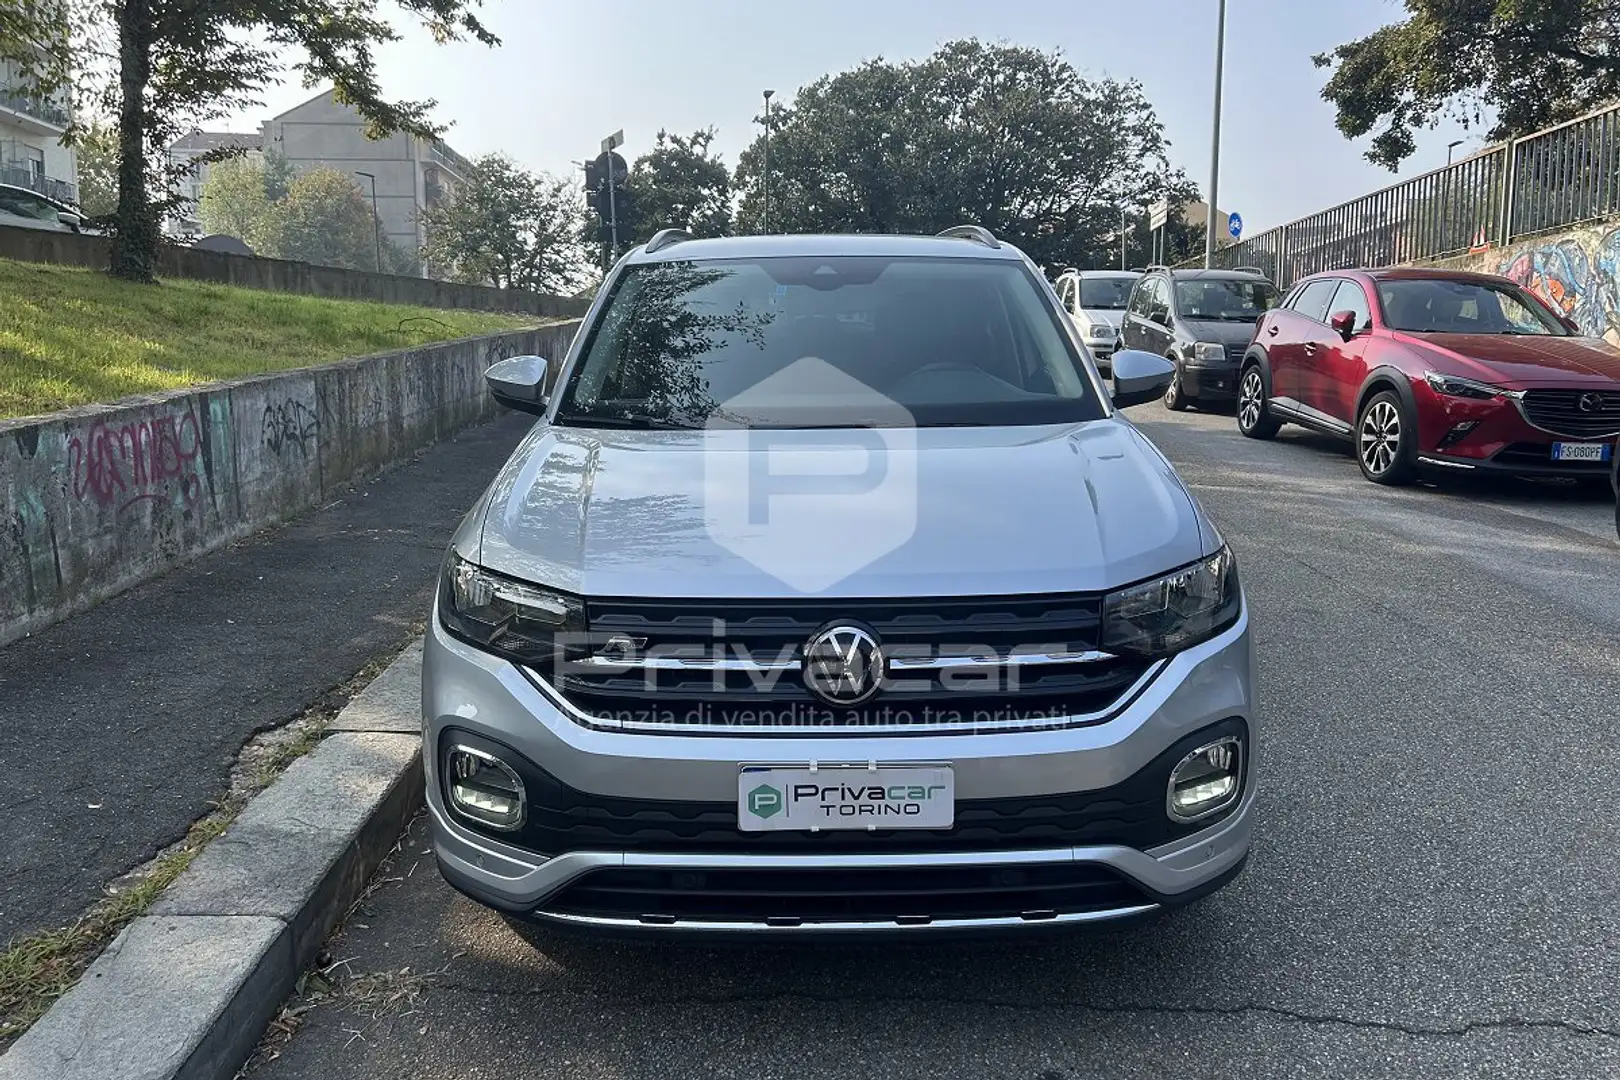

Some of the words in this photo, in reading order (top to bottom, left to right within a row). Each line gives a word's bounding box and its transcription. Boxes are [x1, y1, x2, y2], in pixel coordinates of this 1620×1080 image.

[793, 783, 946, 802] Privacar
[754, 793, 778, 810] P
[820, 803, 920, 816] TORINO
